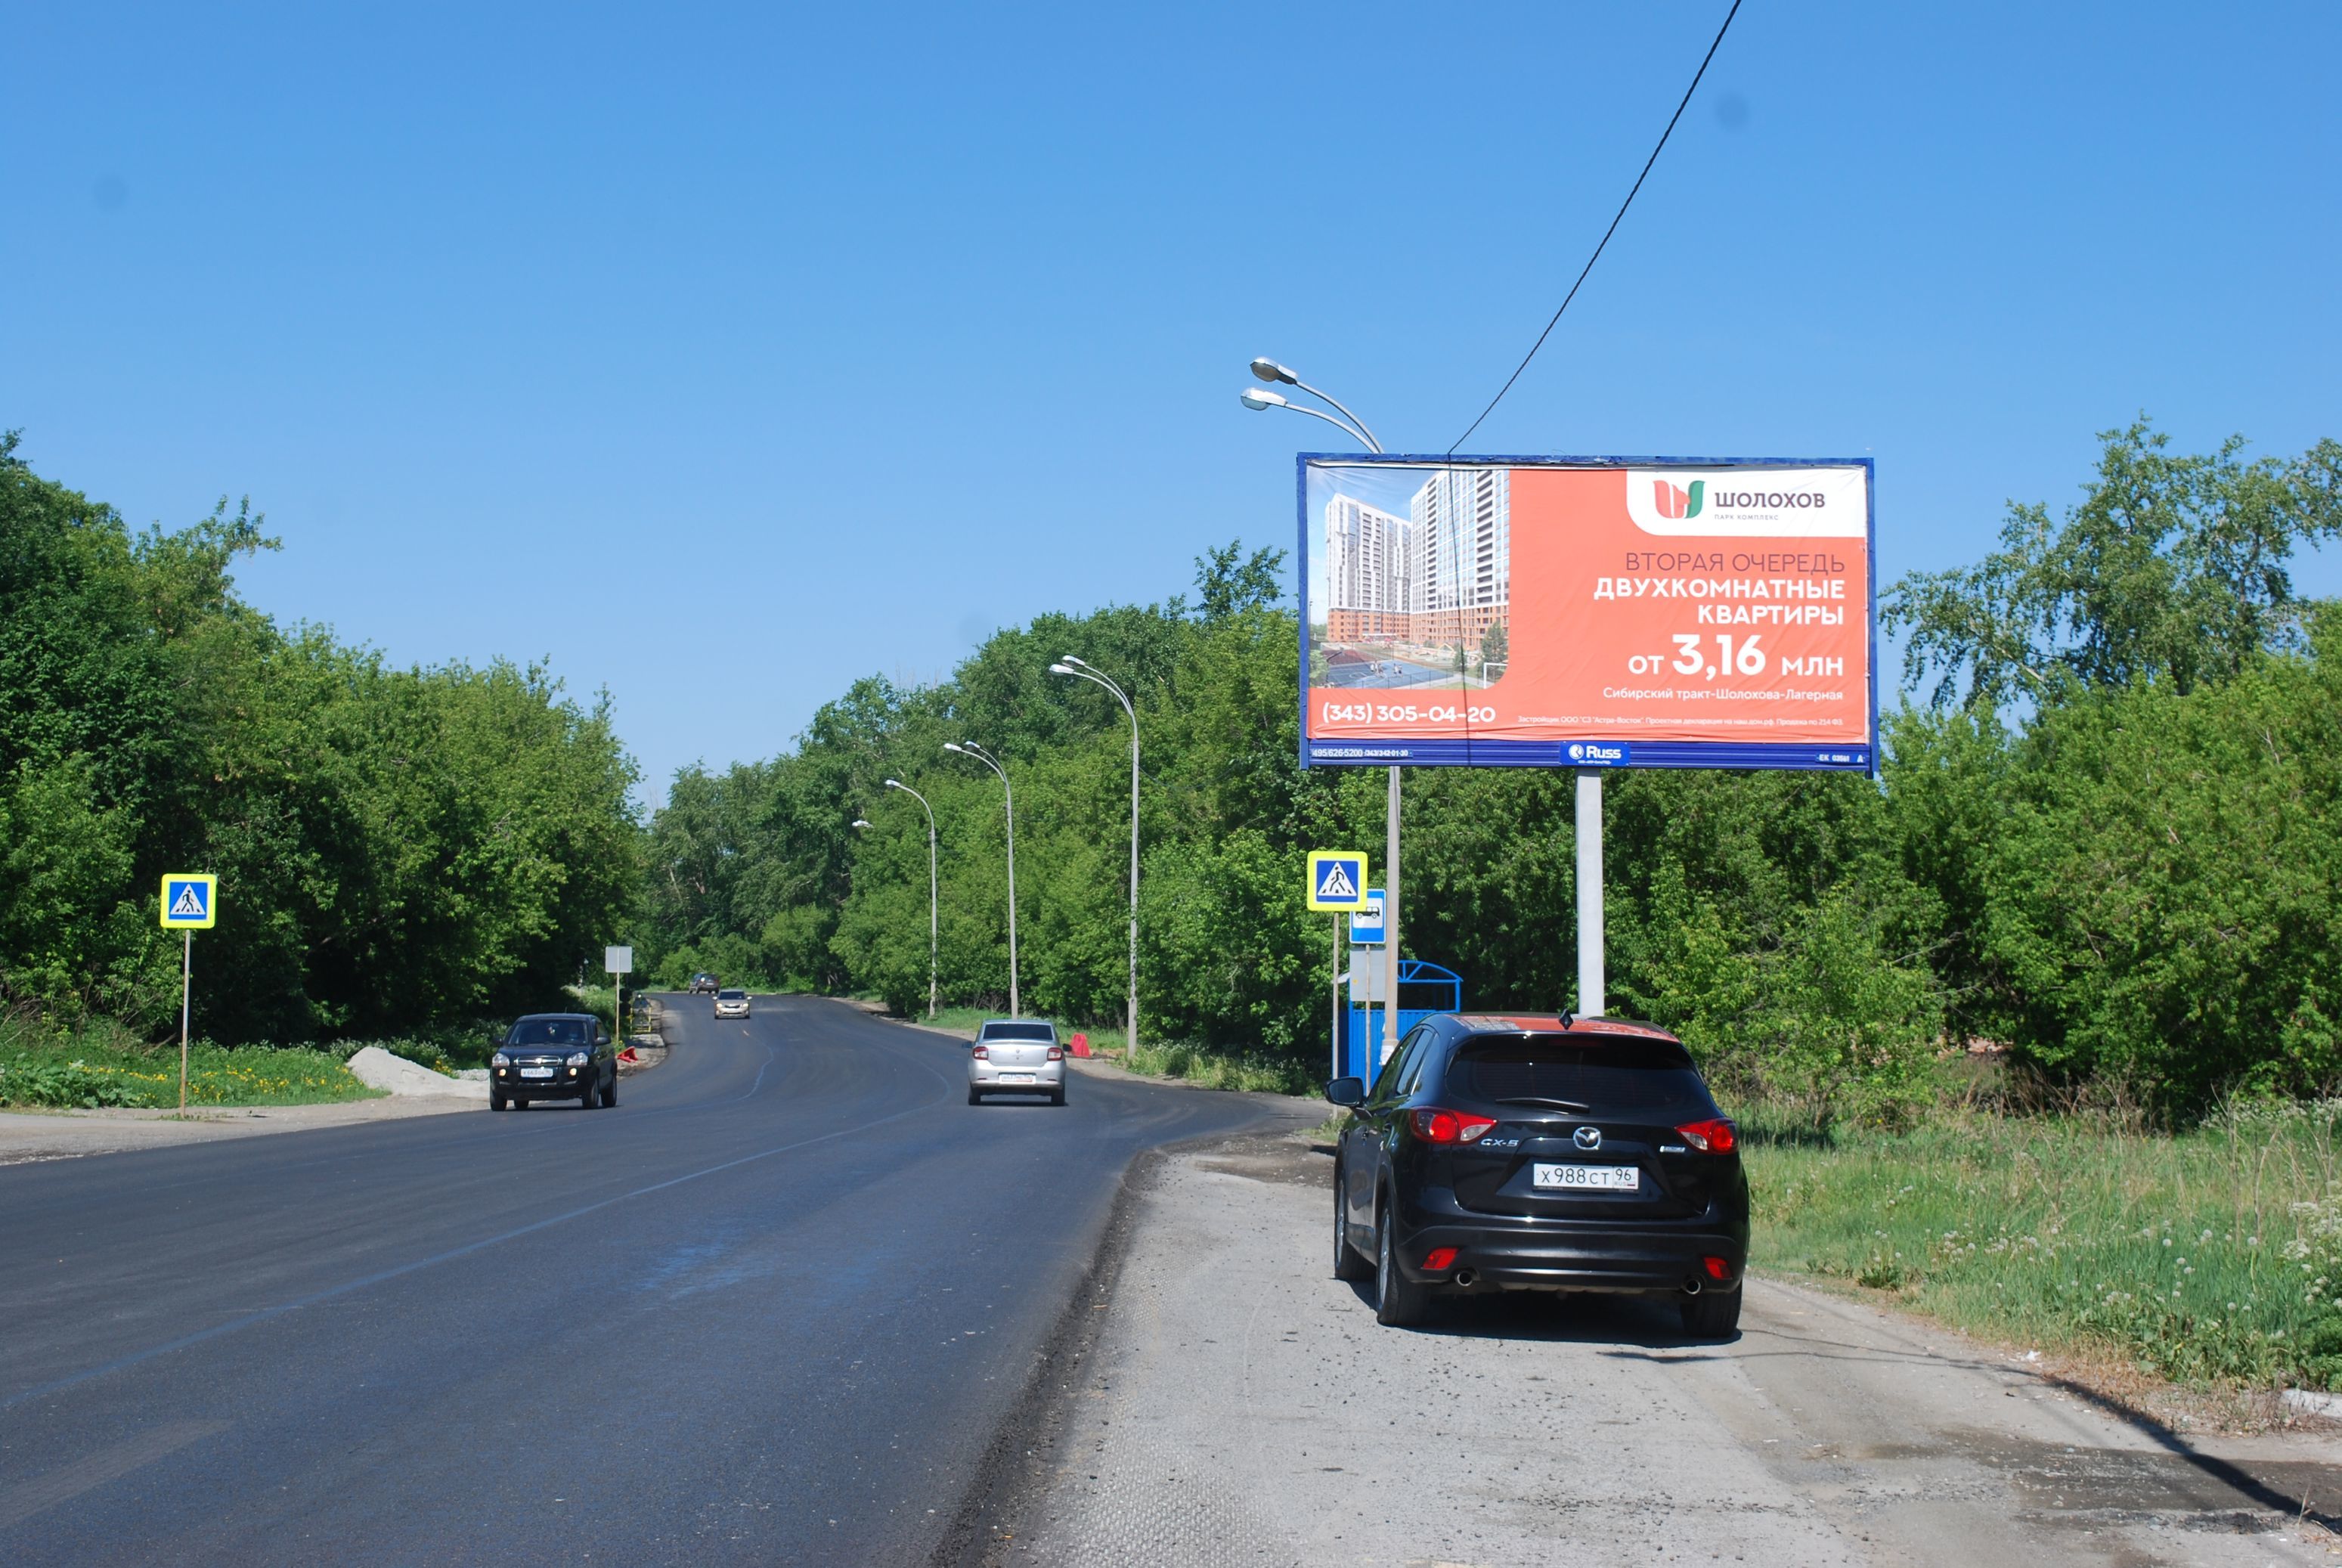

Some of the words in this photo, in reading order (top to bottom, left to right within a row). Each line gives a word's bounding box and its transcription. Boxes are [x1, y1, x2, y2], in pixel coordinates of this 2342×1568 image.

[1714, 492, 1826, 509] ШОЛОХОВ
[1626, 553, 1724, 572] ВТОРАЯ
[1732, 553, 1845, 575] ОЧЕРЕДЬ
[1594, 578, 1845, 600] ДВУХКОМНАТНЫЕ
[1698, 605, 1844, 625] КВАРТИРЫ
[1671, 634, 1766, 681] 3,16
[1603, 687, 1674, 701] Сибирский
[1676, 688, 1843, 702] тракт-Шолохова-Лагерная
[1322, 702, 1373, 724] (343)
[1376, 705, 1497, 724] 305-04-20
[1586, 745, 1622, 759] Russ
[1480, 1138, 1520, 1147] CX-5
